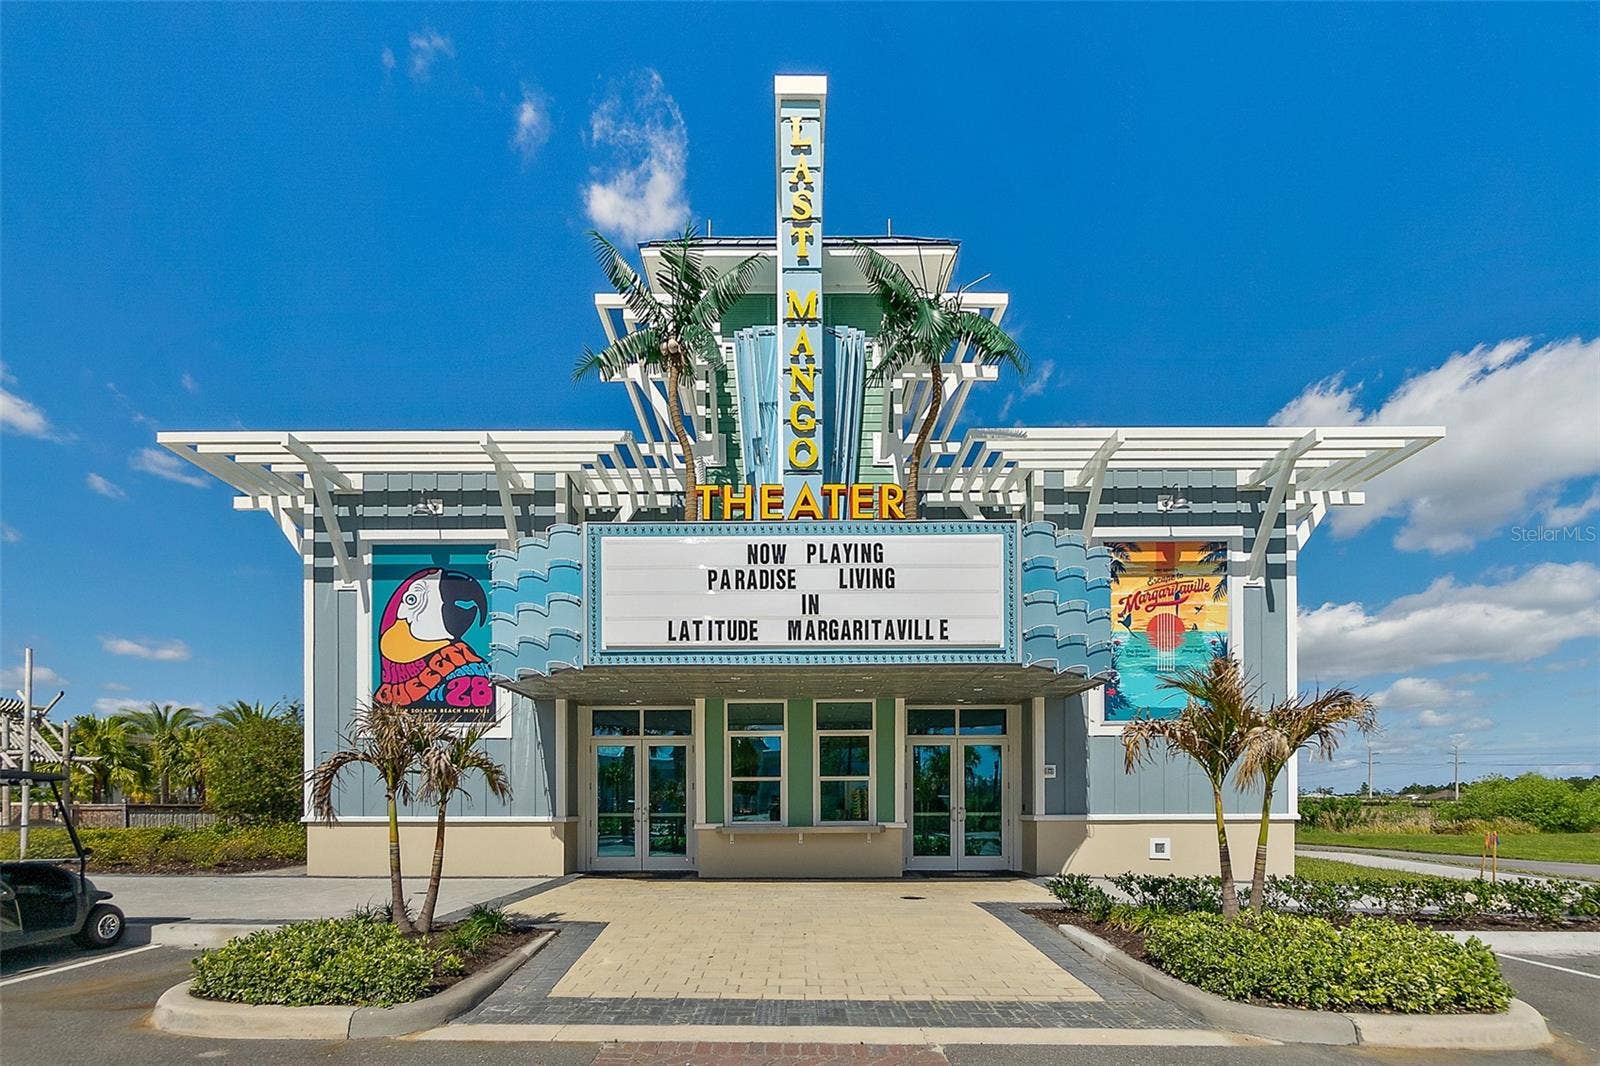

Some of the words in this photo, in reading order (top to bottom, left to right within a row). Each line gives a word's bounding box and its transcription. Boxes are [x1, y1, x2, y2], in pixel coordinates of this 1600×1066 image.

[789, 116, 814, 257] LAST
[786, 289, 819, 469] MANGO
[695, 481, 907, 521] THEATER
[747, 543, 787, 565] NOW
[806, 543, 884, 565] PLAYING
[707, 568, 796, 590] PARADISE
[838, 568, 896, 590] LIVING
[1147, 574, 1175, 586] Escape
[1176, 572, 1184, 580] to
[801, 594, 819, 615] IN
[1117, 578, 1211, 618] Margaritaville
[668, 619, 759, 642] LATITUDE
[787, 619, 949, 642] MARGARITAVILLE
[445, 675, 493, 707] 28
